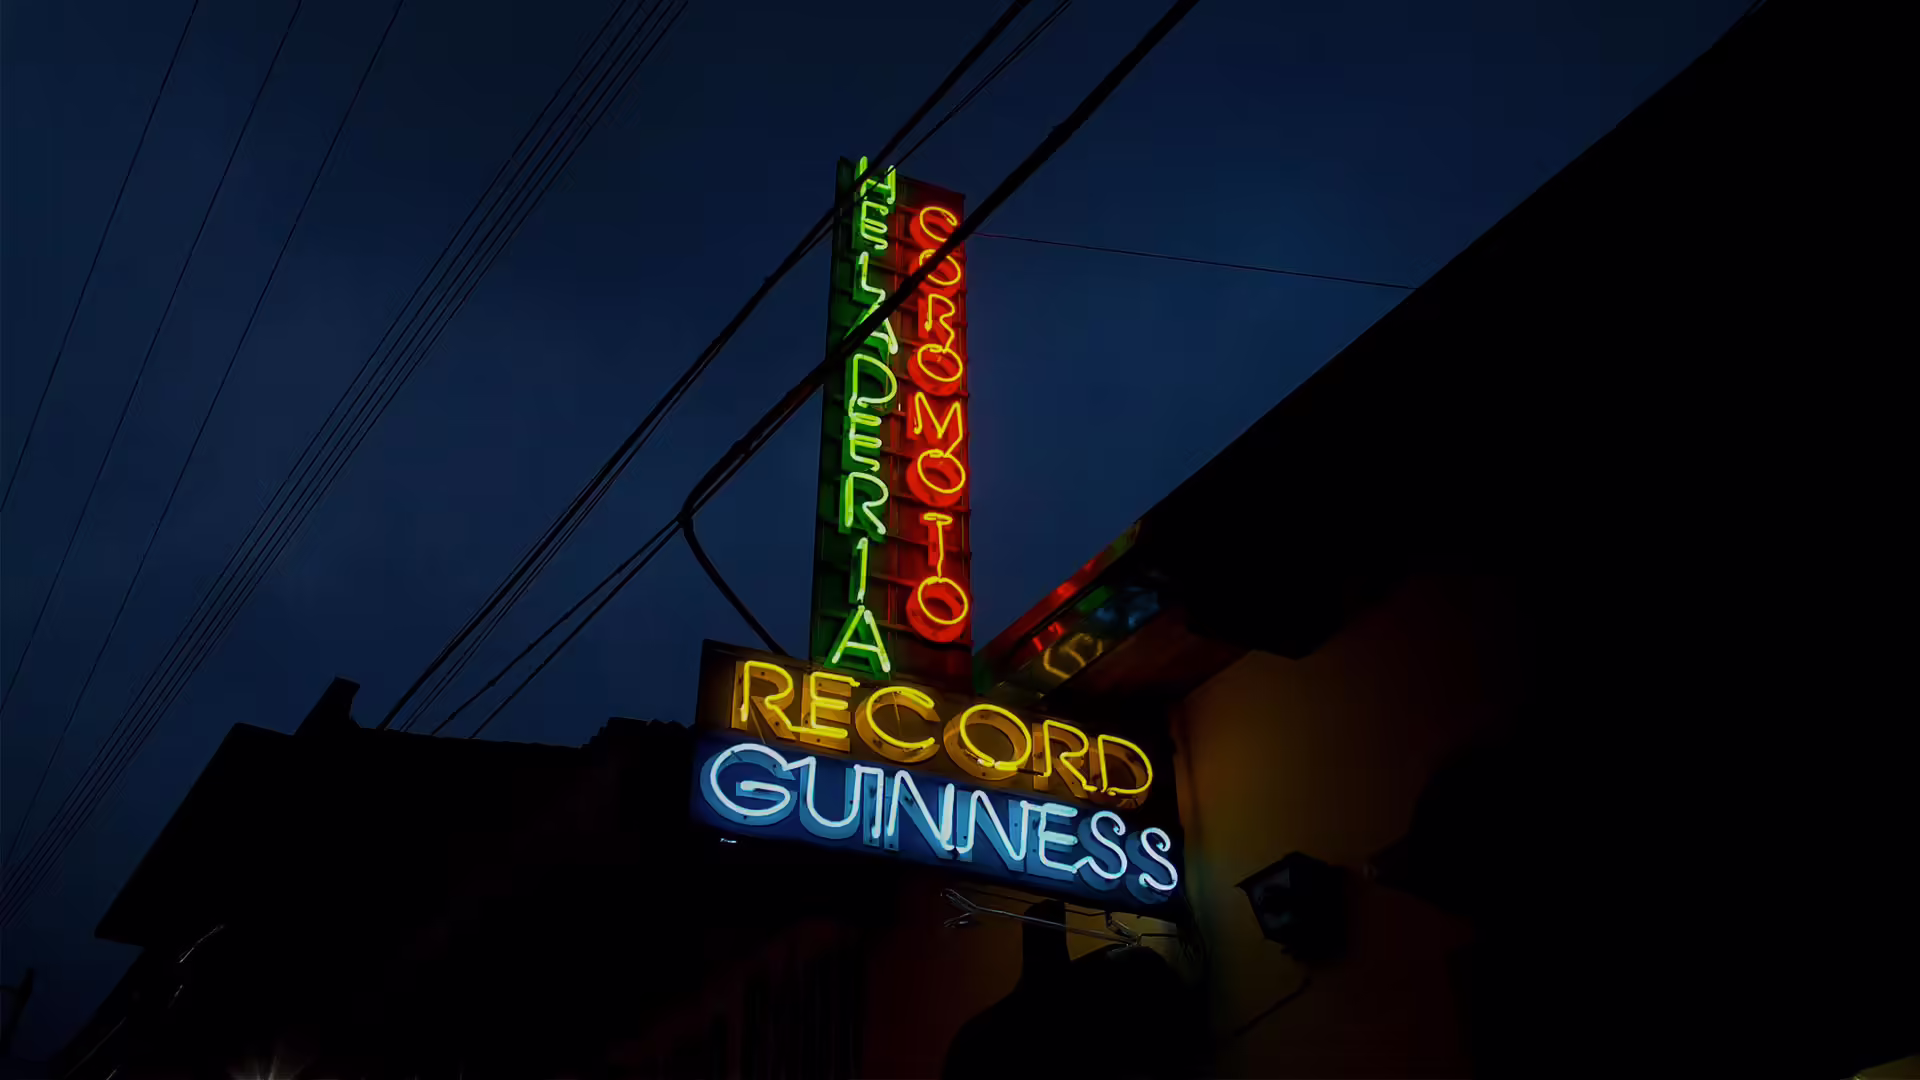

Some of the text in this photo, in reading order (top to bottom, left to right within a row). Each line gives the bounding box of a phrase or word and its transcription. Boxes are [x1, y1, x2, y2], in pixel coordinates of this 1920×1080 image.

[826, 156, 899, 677] HELADERIA
[908, 205, 970, 634] COROMOTO
[704, 742, 1180, 899] GUINNESS
[734, 659, 1154, 799] RECORD
